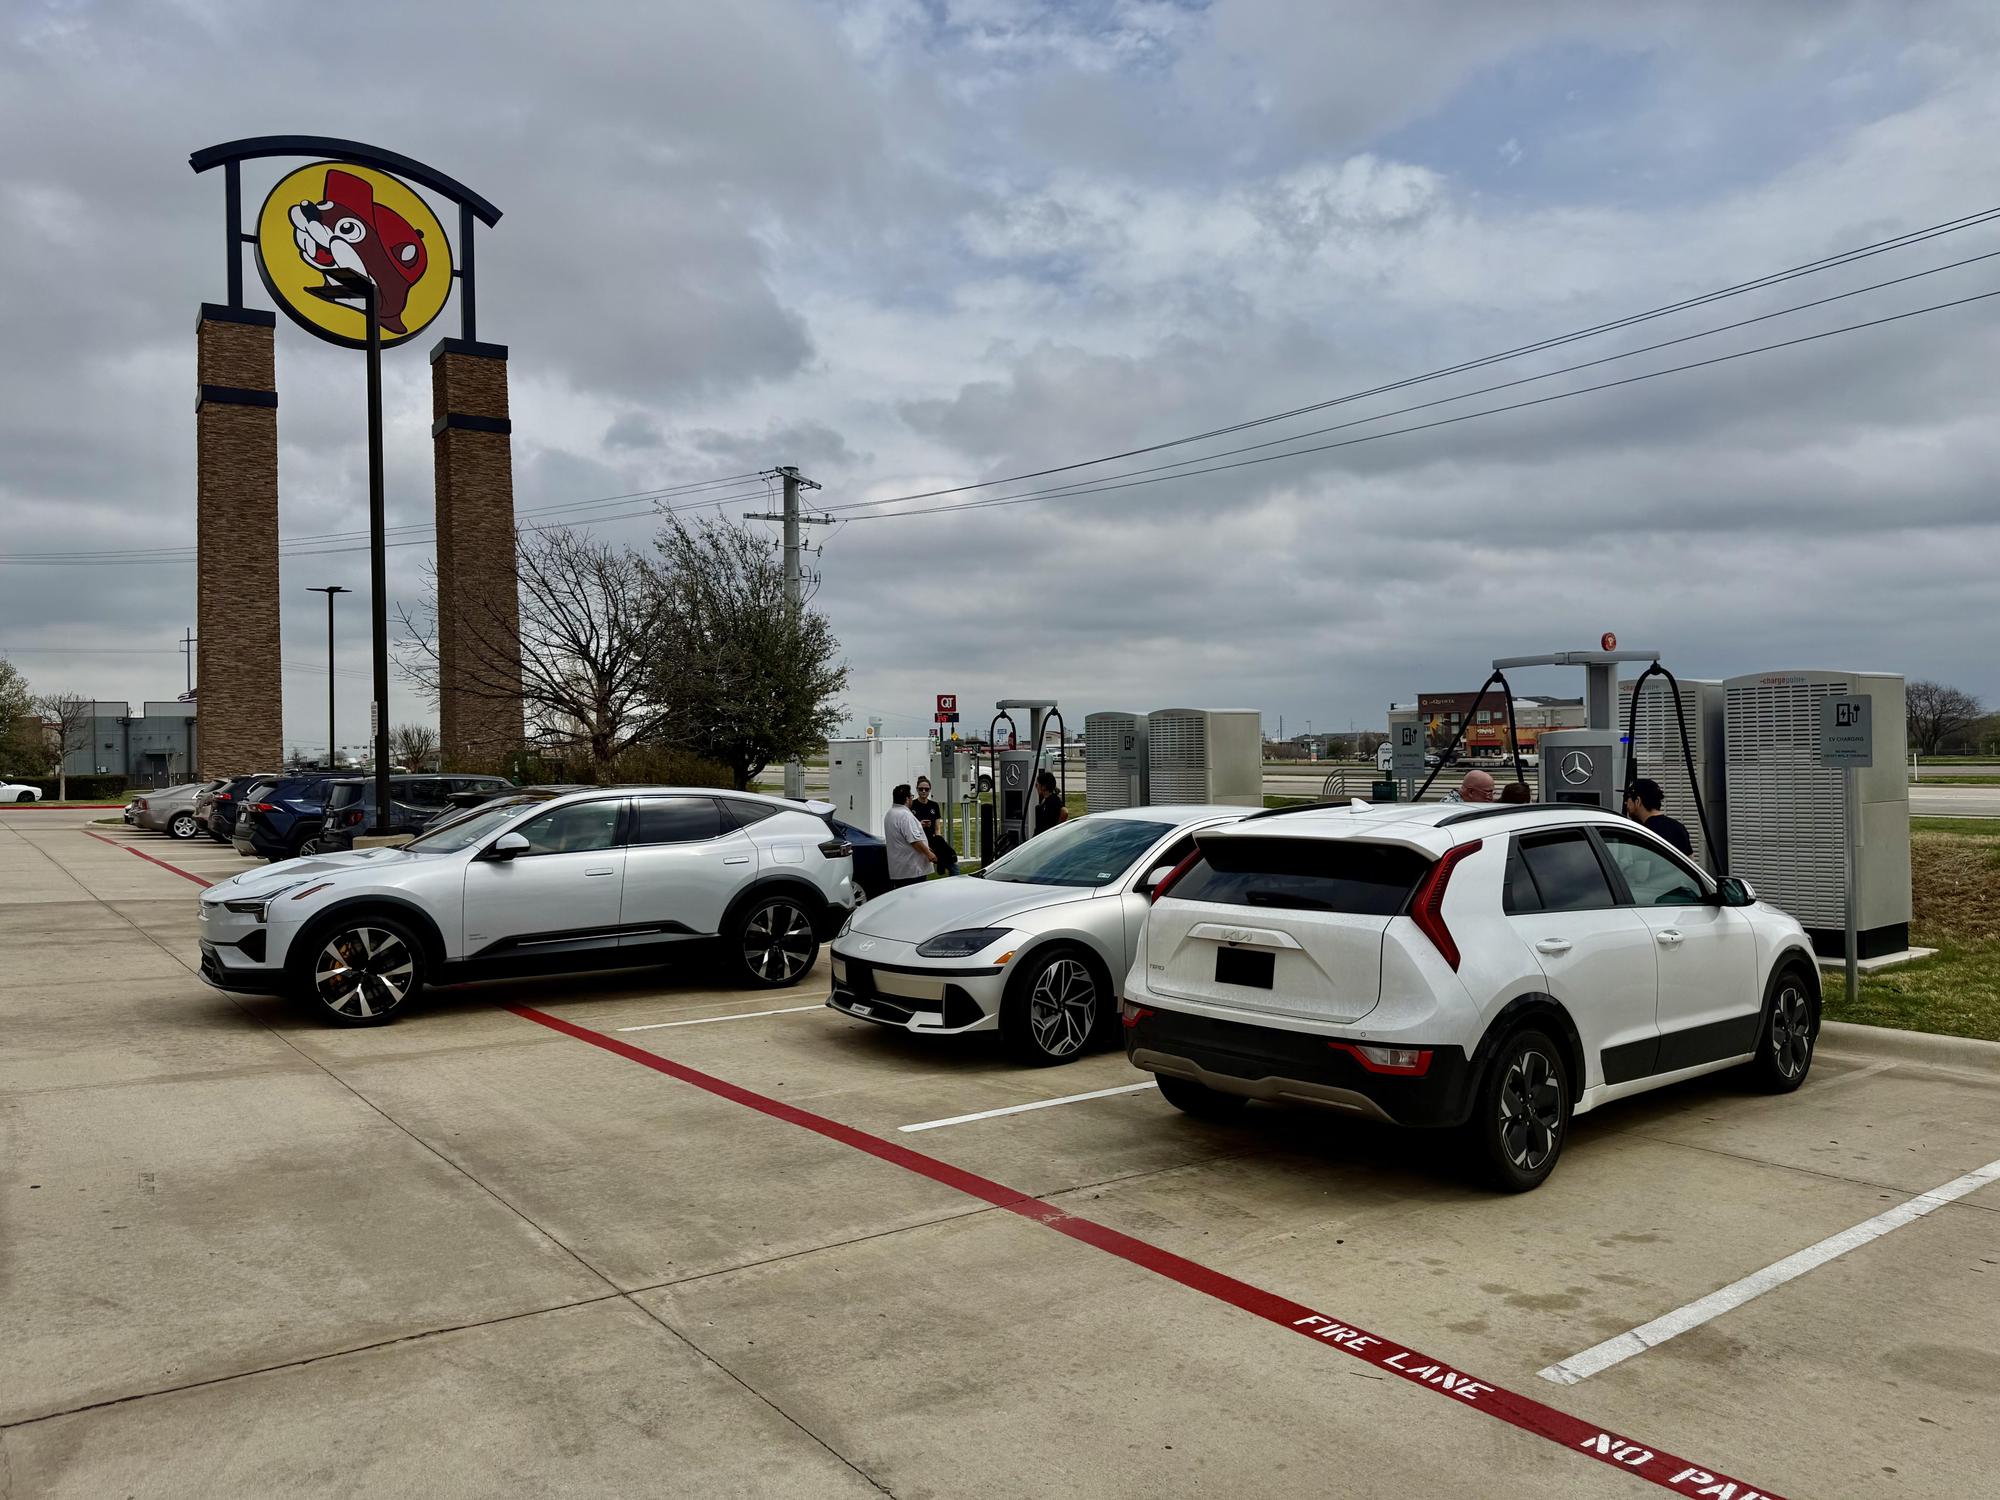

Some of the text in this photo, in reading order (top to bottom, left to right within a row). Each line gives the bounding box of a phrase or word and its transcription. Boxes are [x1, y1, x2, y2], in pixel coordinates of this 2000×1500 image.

[941, 697, 954, 708] QT
[1293, 1315, 1382, 1351] FIRE
[1383, 1352, 1495, 1400] LANE
[1580, 1433, 1654, 1466] NO
